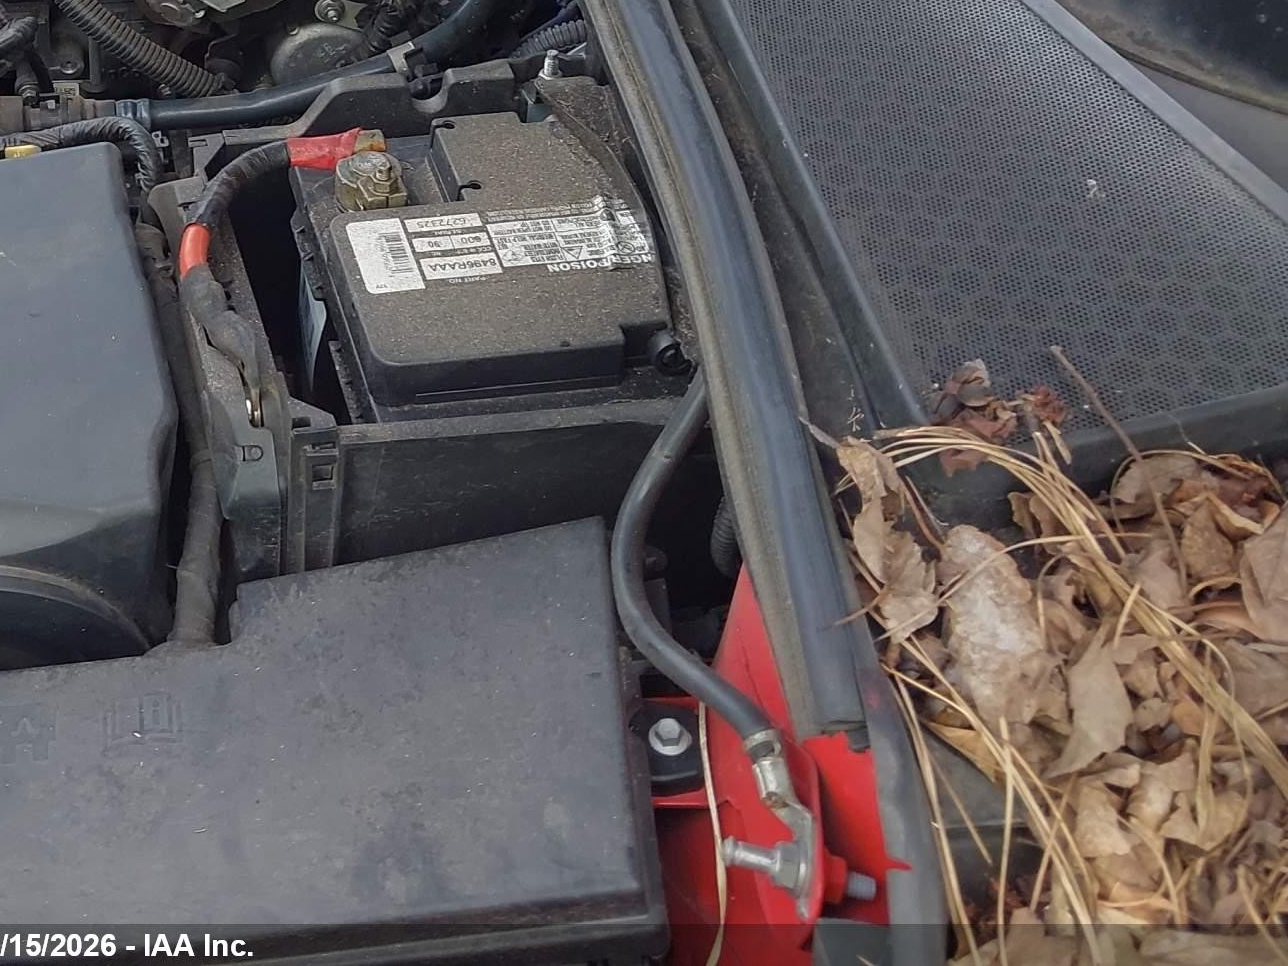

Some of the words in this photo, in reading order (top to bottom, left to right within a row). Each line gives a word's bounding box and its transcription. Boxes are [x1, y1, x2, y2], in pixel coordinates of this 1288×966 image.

[416, 217, 467, 229] 6272325
[428, 257, 498, 272] 8496RAAA
[547, 252, 654, 273] NGER/POISON
